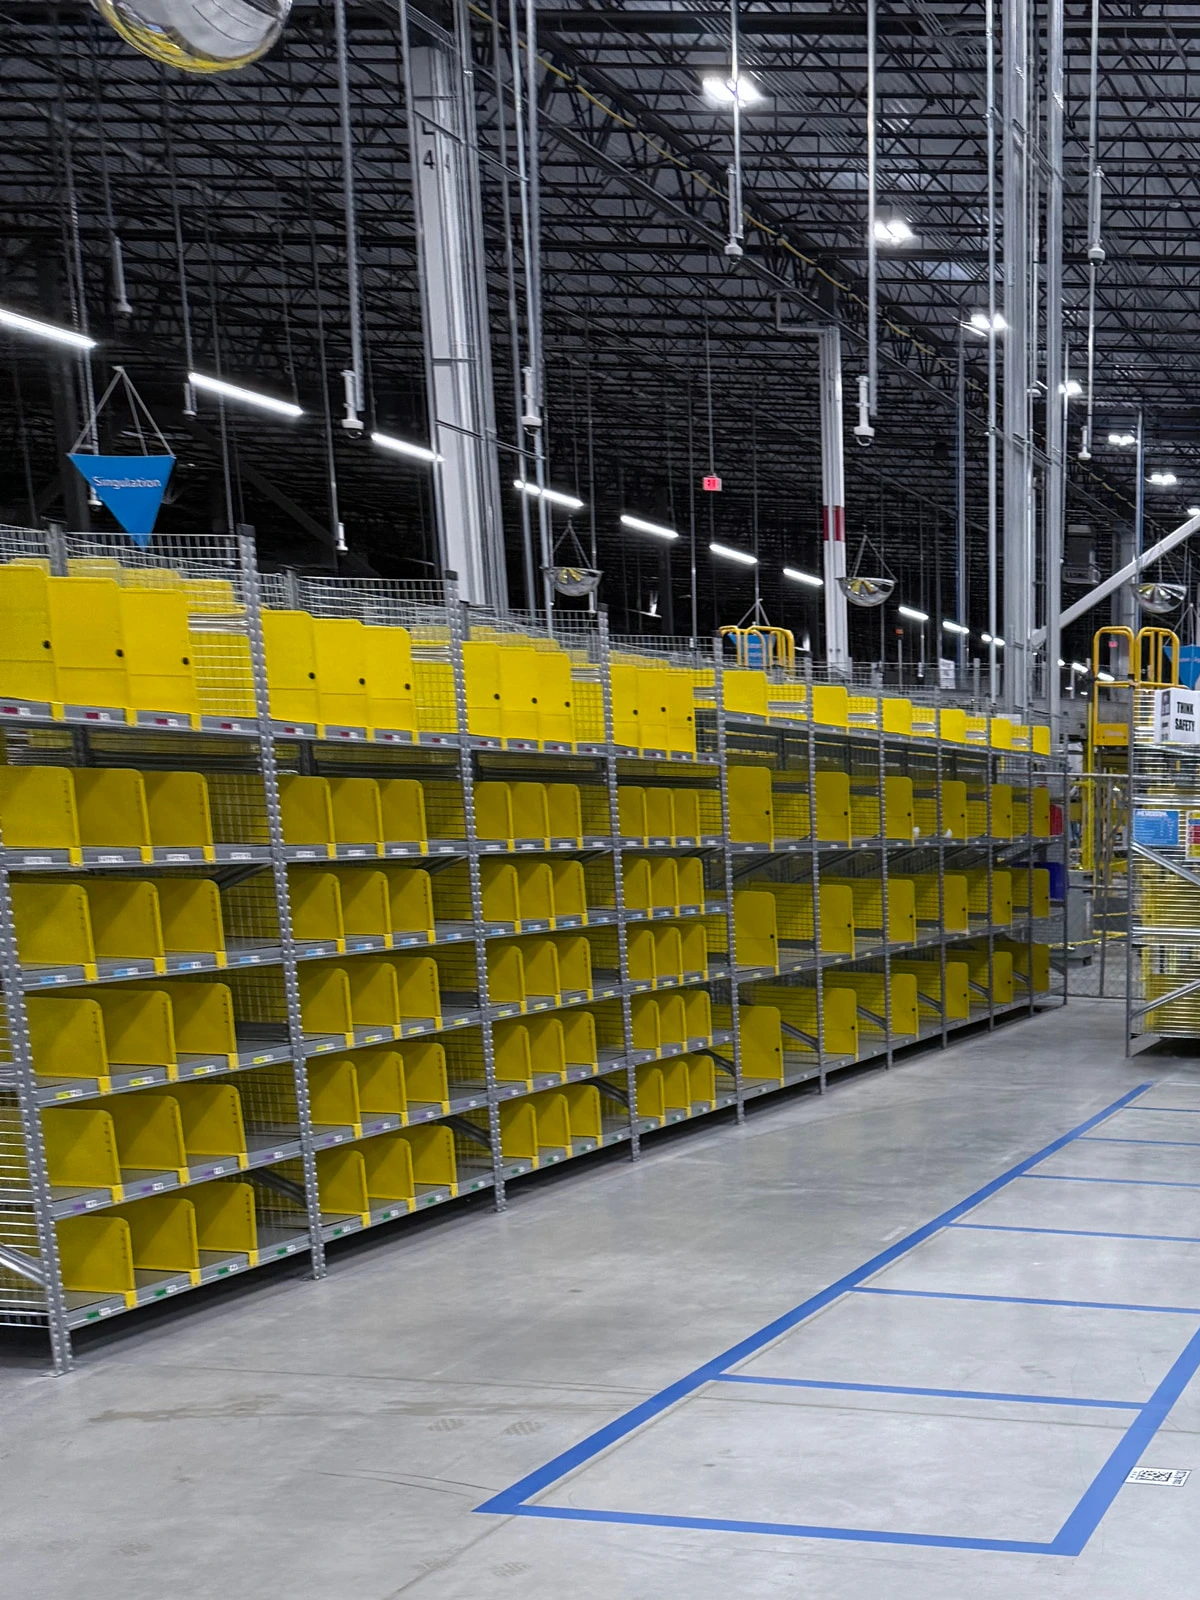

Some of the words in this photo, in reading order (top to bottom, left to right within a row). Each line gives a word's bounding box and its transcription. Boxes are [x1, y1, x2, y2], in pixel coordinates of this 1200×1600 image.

[423, 150, 434, 170] 4
[92, 476, 161, 490] Singulation
[1175, 718, 1195, 732] SAFETY
